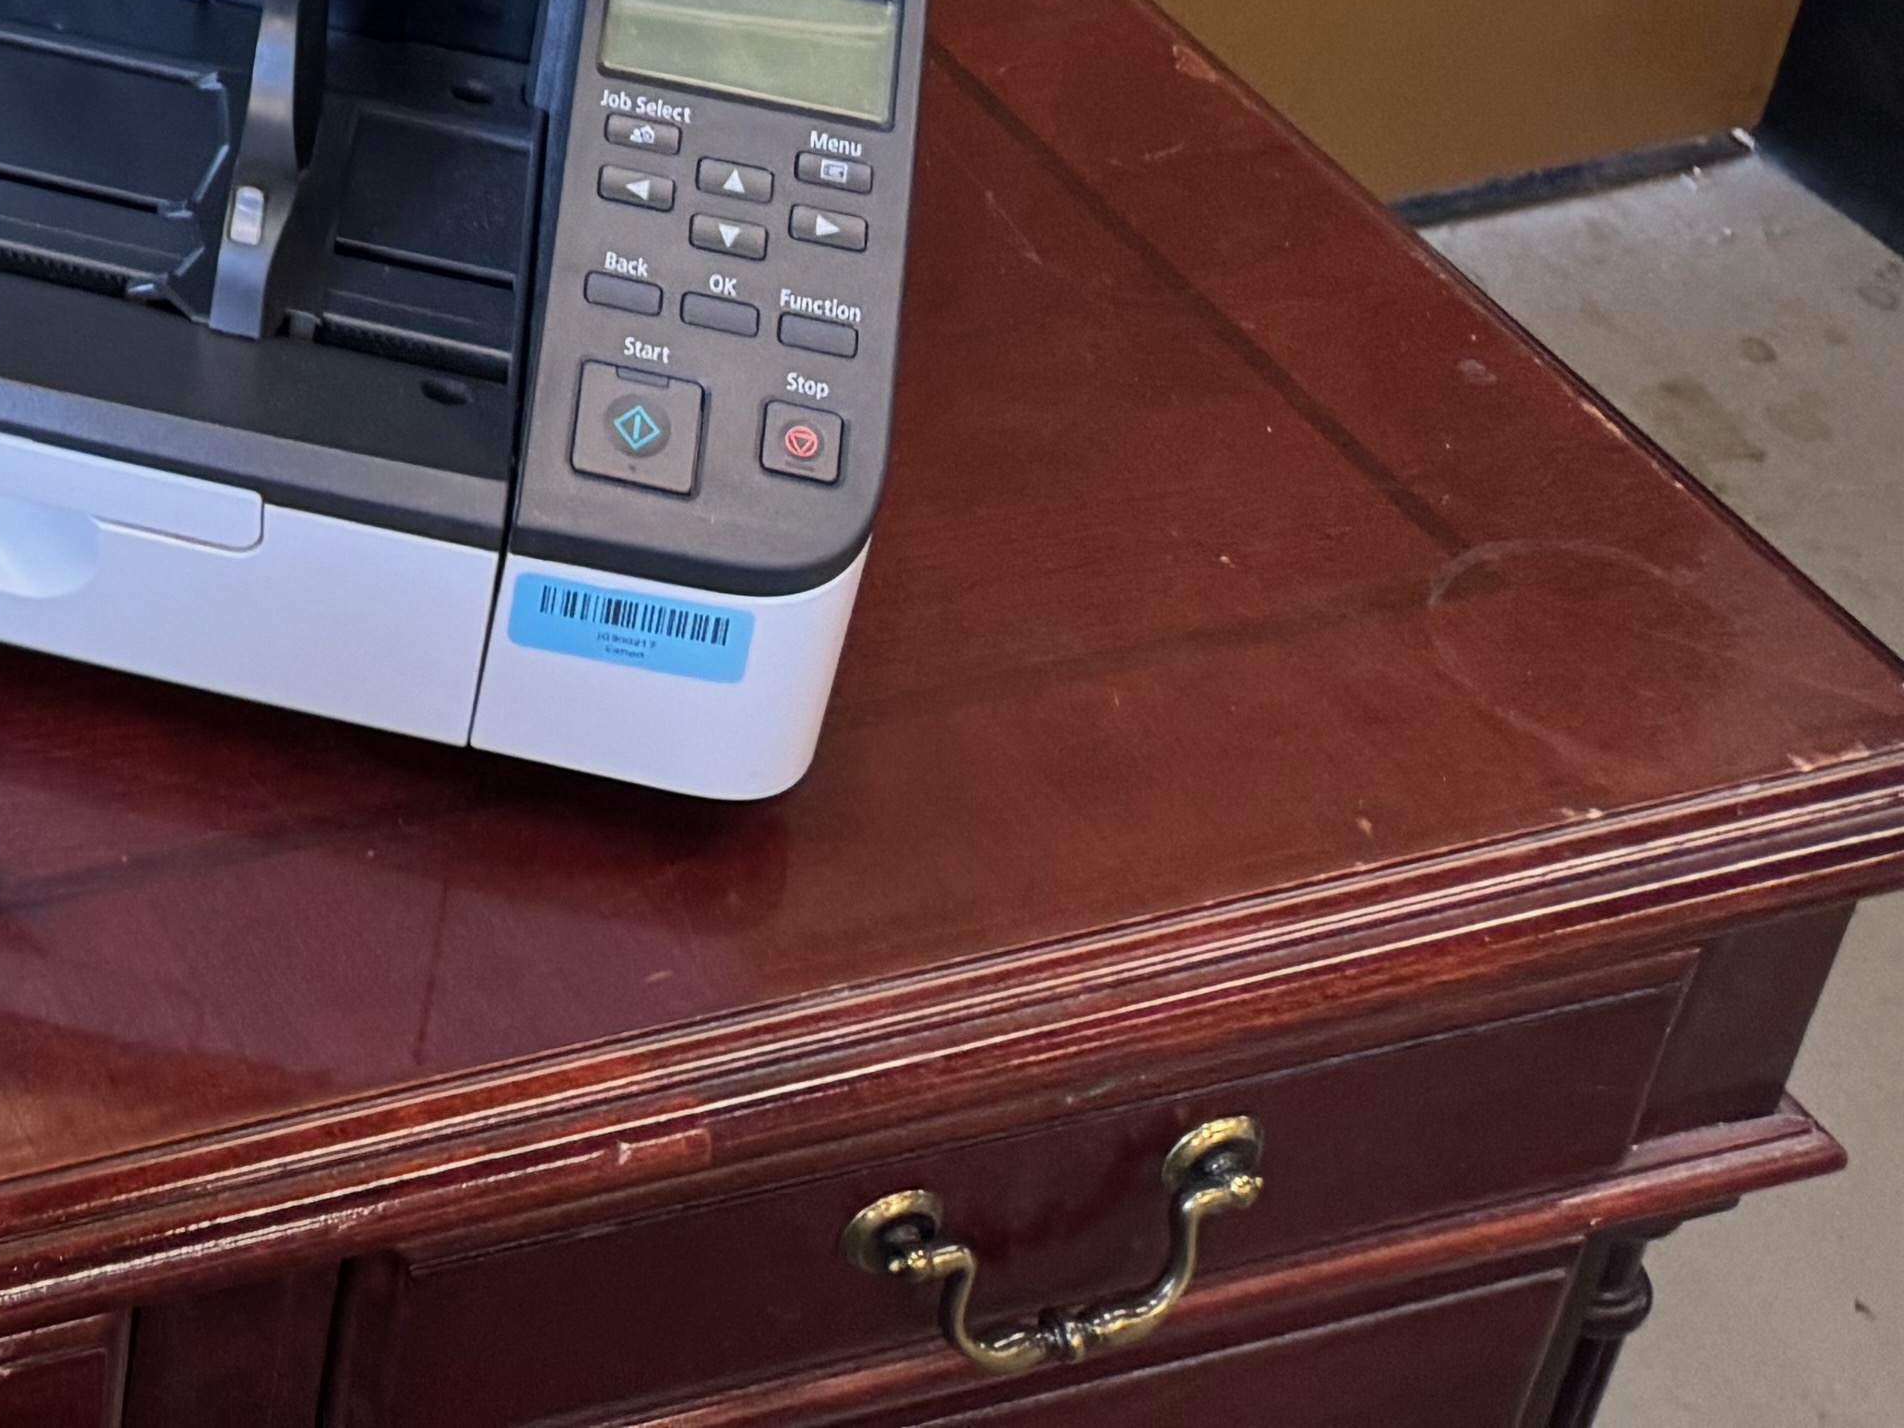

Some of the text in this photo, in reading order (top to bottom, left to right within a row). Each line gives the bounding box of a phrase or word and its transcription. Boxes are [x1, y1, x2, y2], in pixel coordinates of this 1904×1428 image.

[600, 89, 692, 124] Job Select
[809, 130, 863, 158] Menu
[604, 251, 648, 277] Back
[708, 274, 737, 297] OK
[780, 288, 862, 323] Function
[623, 336, 671, 364] Start
[785, 372, 830, 400] Stop
